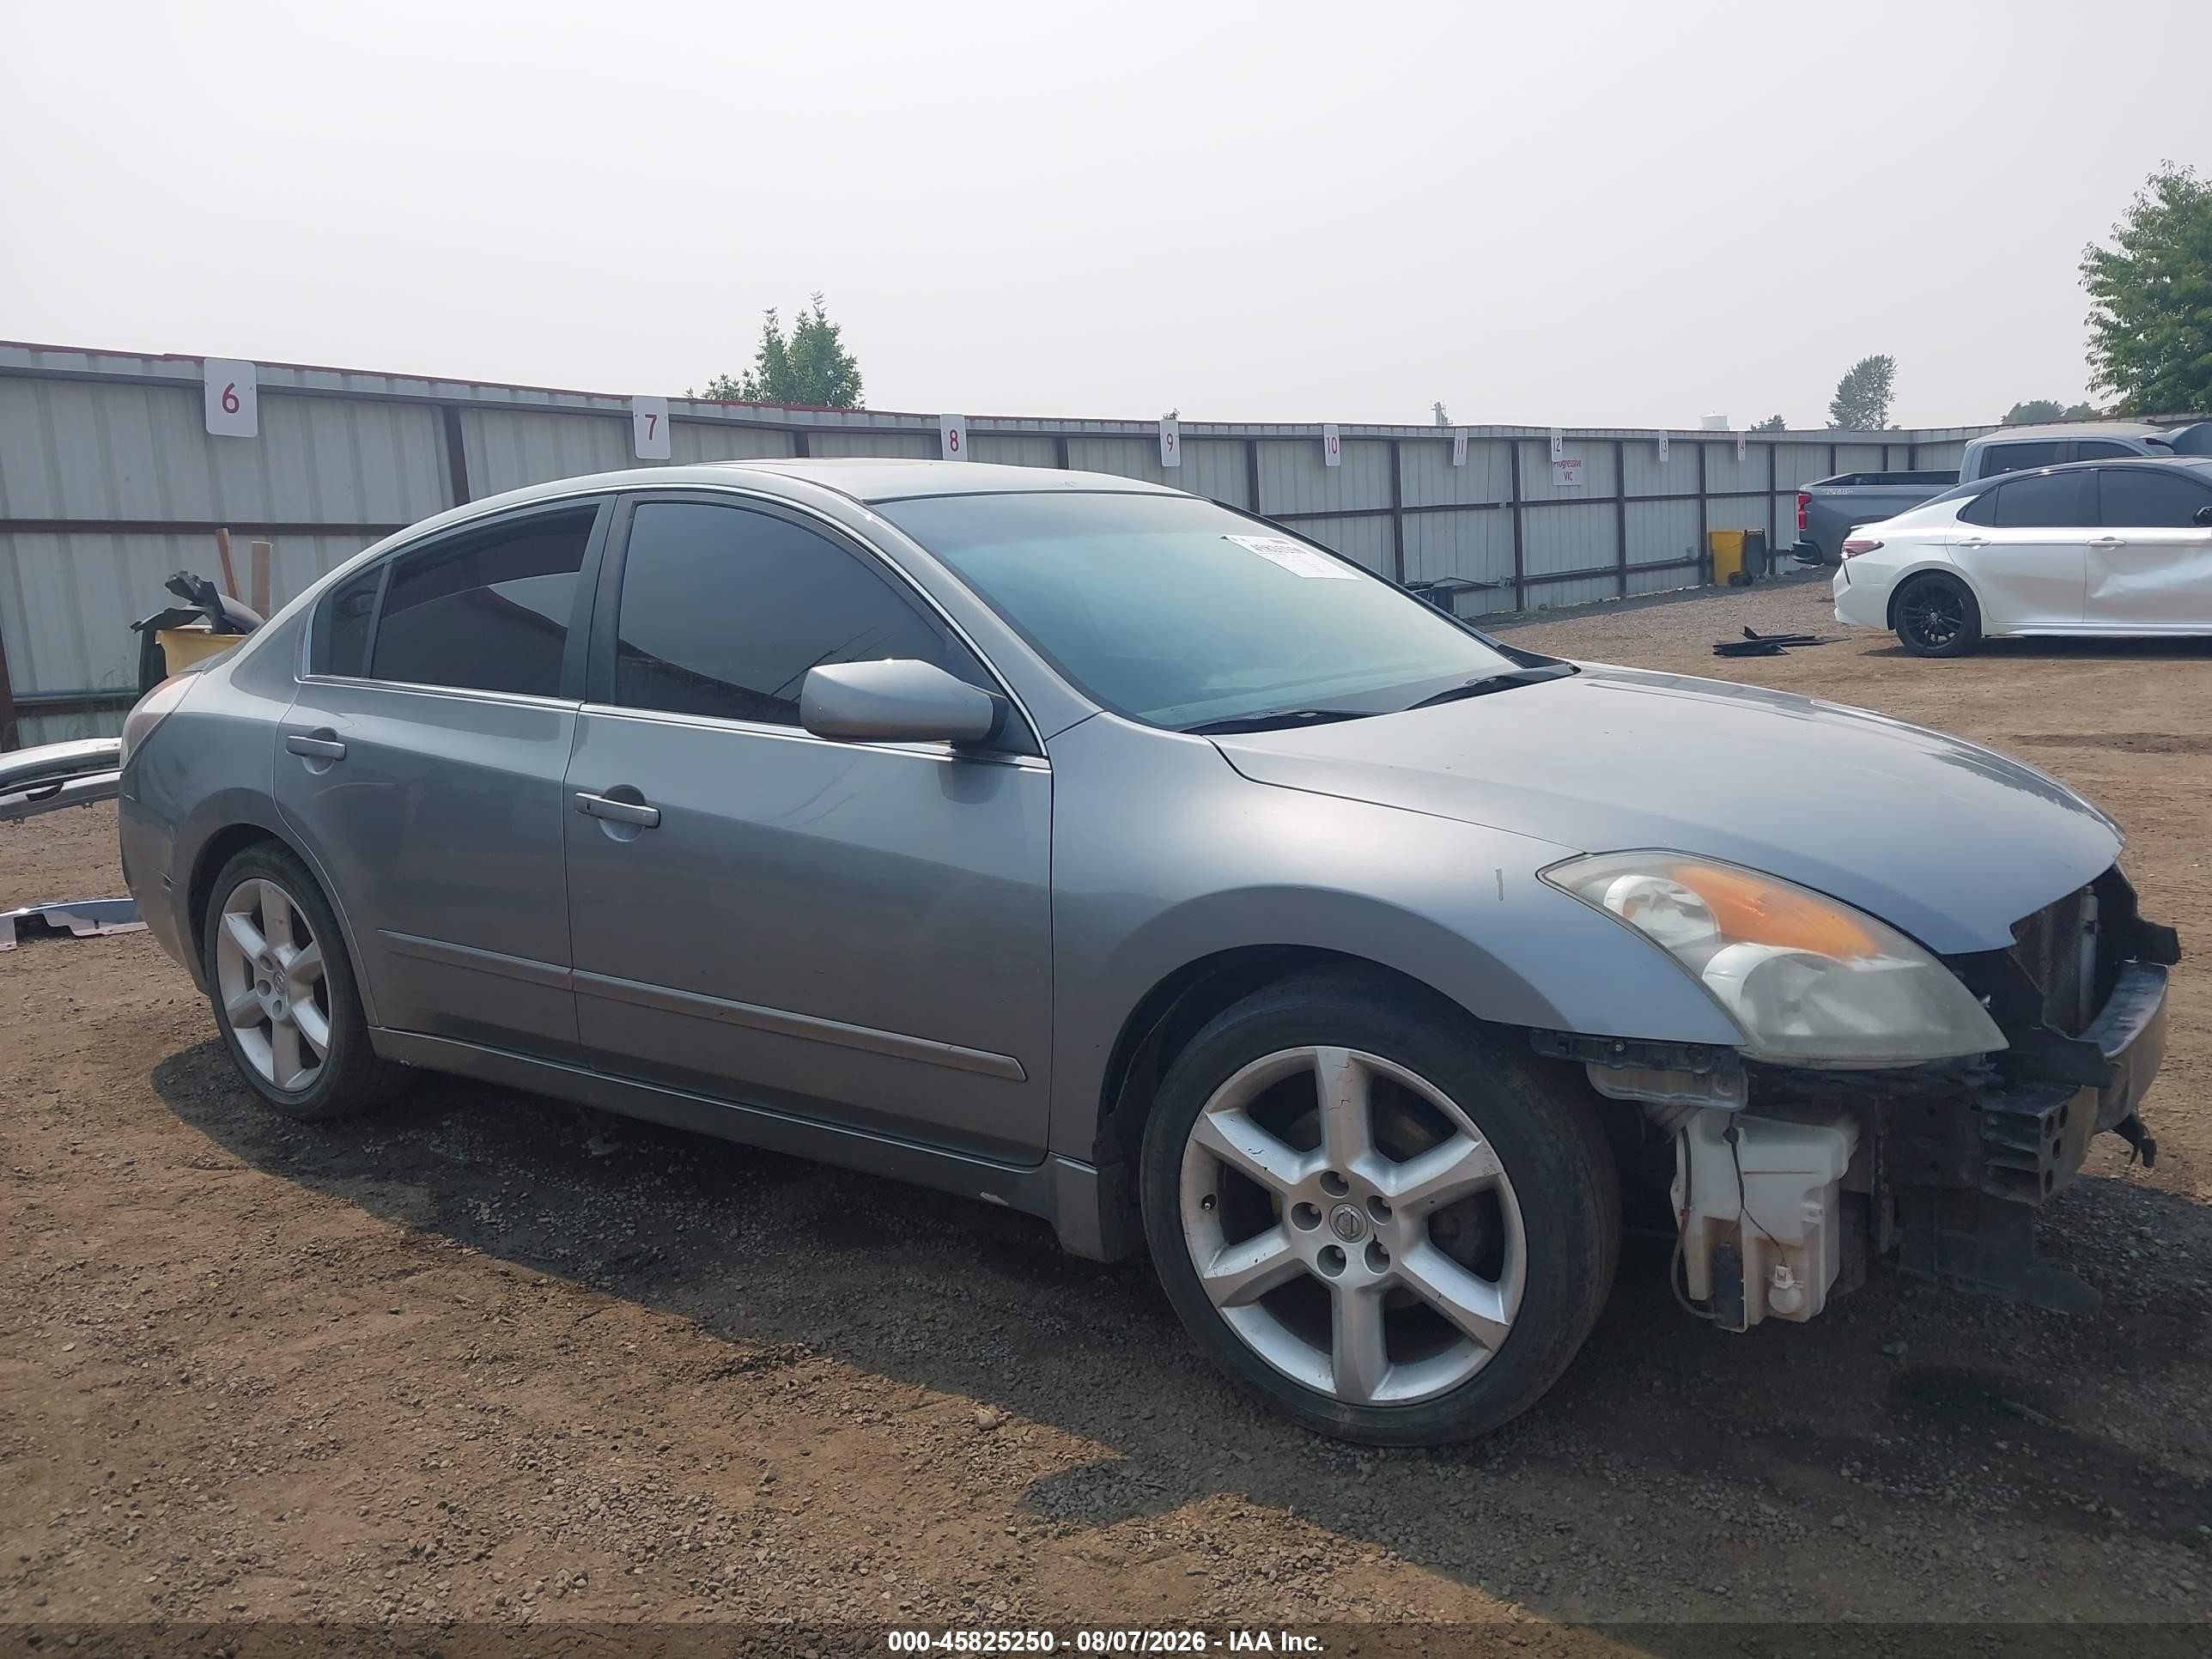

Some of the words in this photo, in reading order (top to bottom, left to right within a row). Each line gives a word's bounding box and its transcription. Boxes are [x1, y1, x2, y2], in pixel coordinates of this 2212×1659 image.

[222, 382, 240, 414] 6
[644, 413, 658, 441] 7
[949, 428, 960, 453] 8
[1167, 433, 1174, 453] 9
[1327, 436, 1338, 454] 10
[1457, 439, 1465, 456] 11
[1553, 437, 1561, 453] 12
[1660, 438, 1668, 453] 13
[1738, 439, 1746, 453] 14
[1563, 471, 1573, 482] VIC
